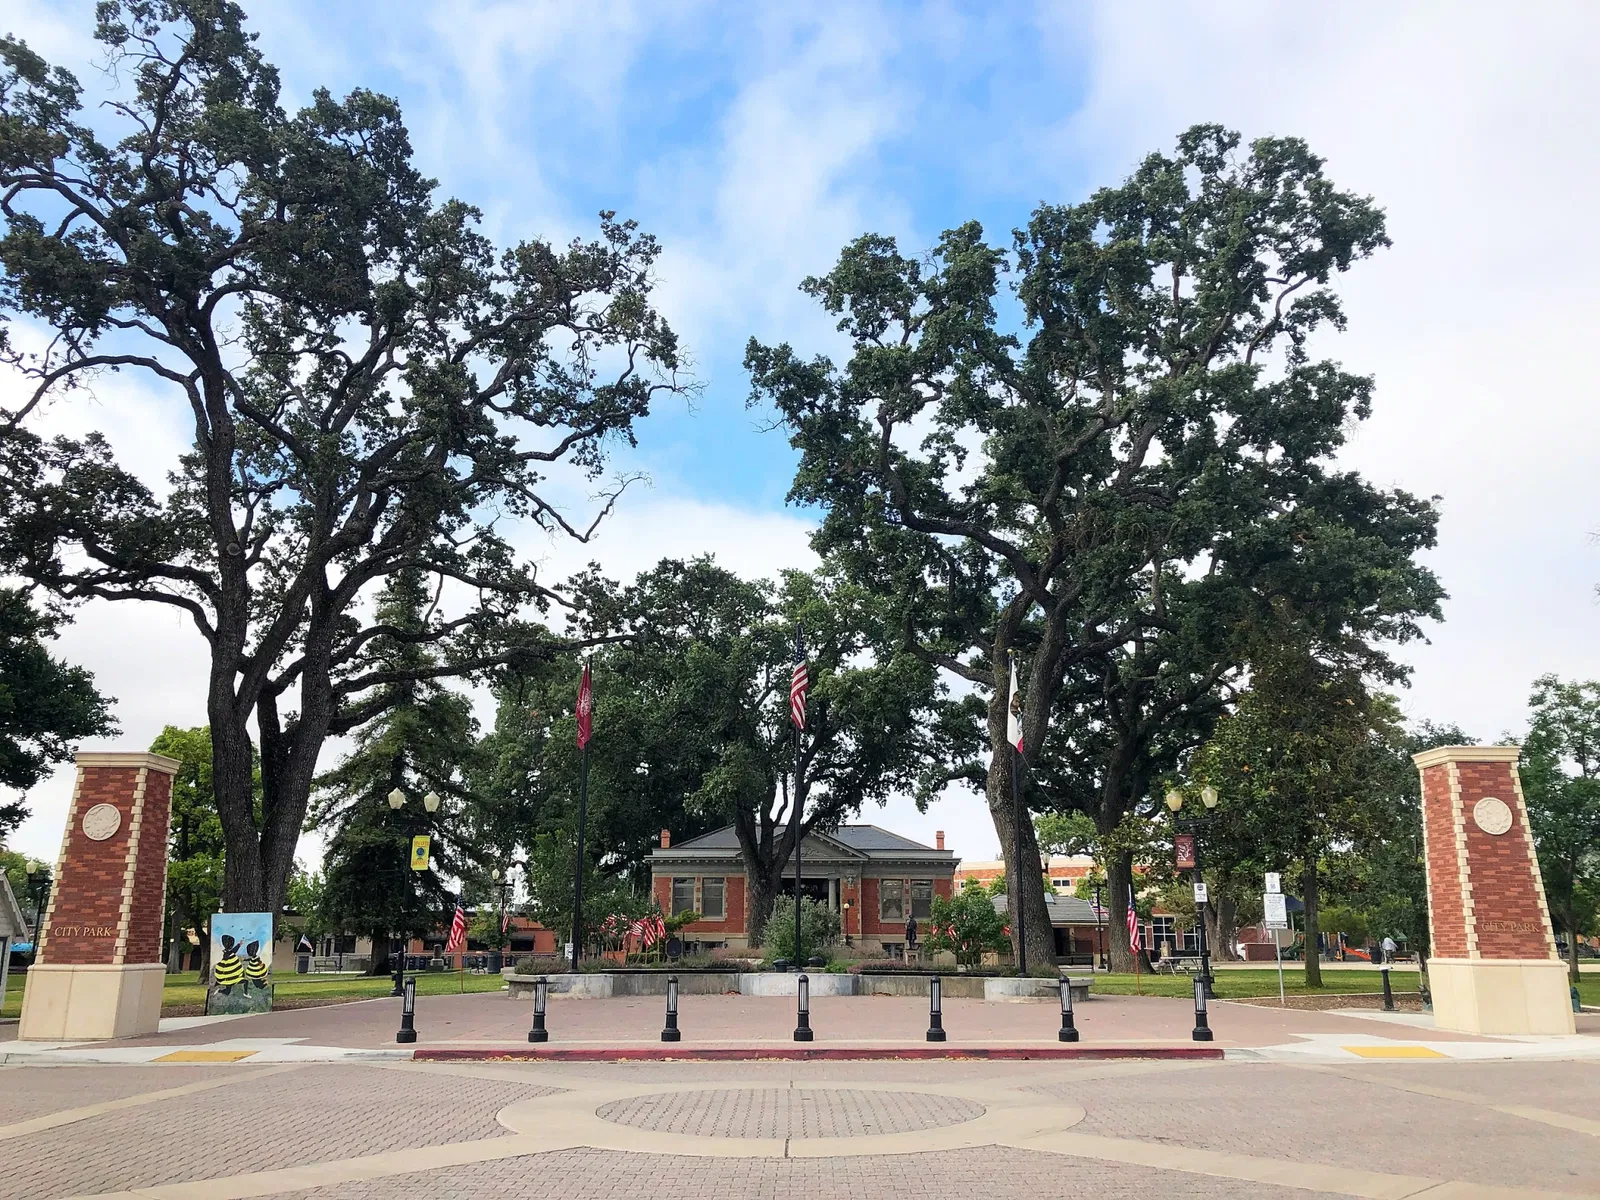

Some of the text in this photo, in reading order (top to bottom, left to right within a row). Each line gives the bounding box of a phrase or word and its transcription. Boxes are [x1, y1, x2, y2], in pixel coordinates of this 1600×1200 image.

[54, 926, 112, 937] CITY PARK
[1481, 922, 1540, 932] CITY PARK
